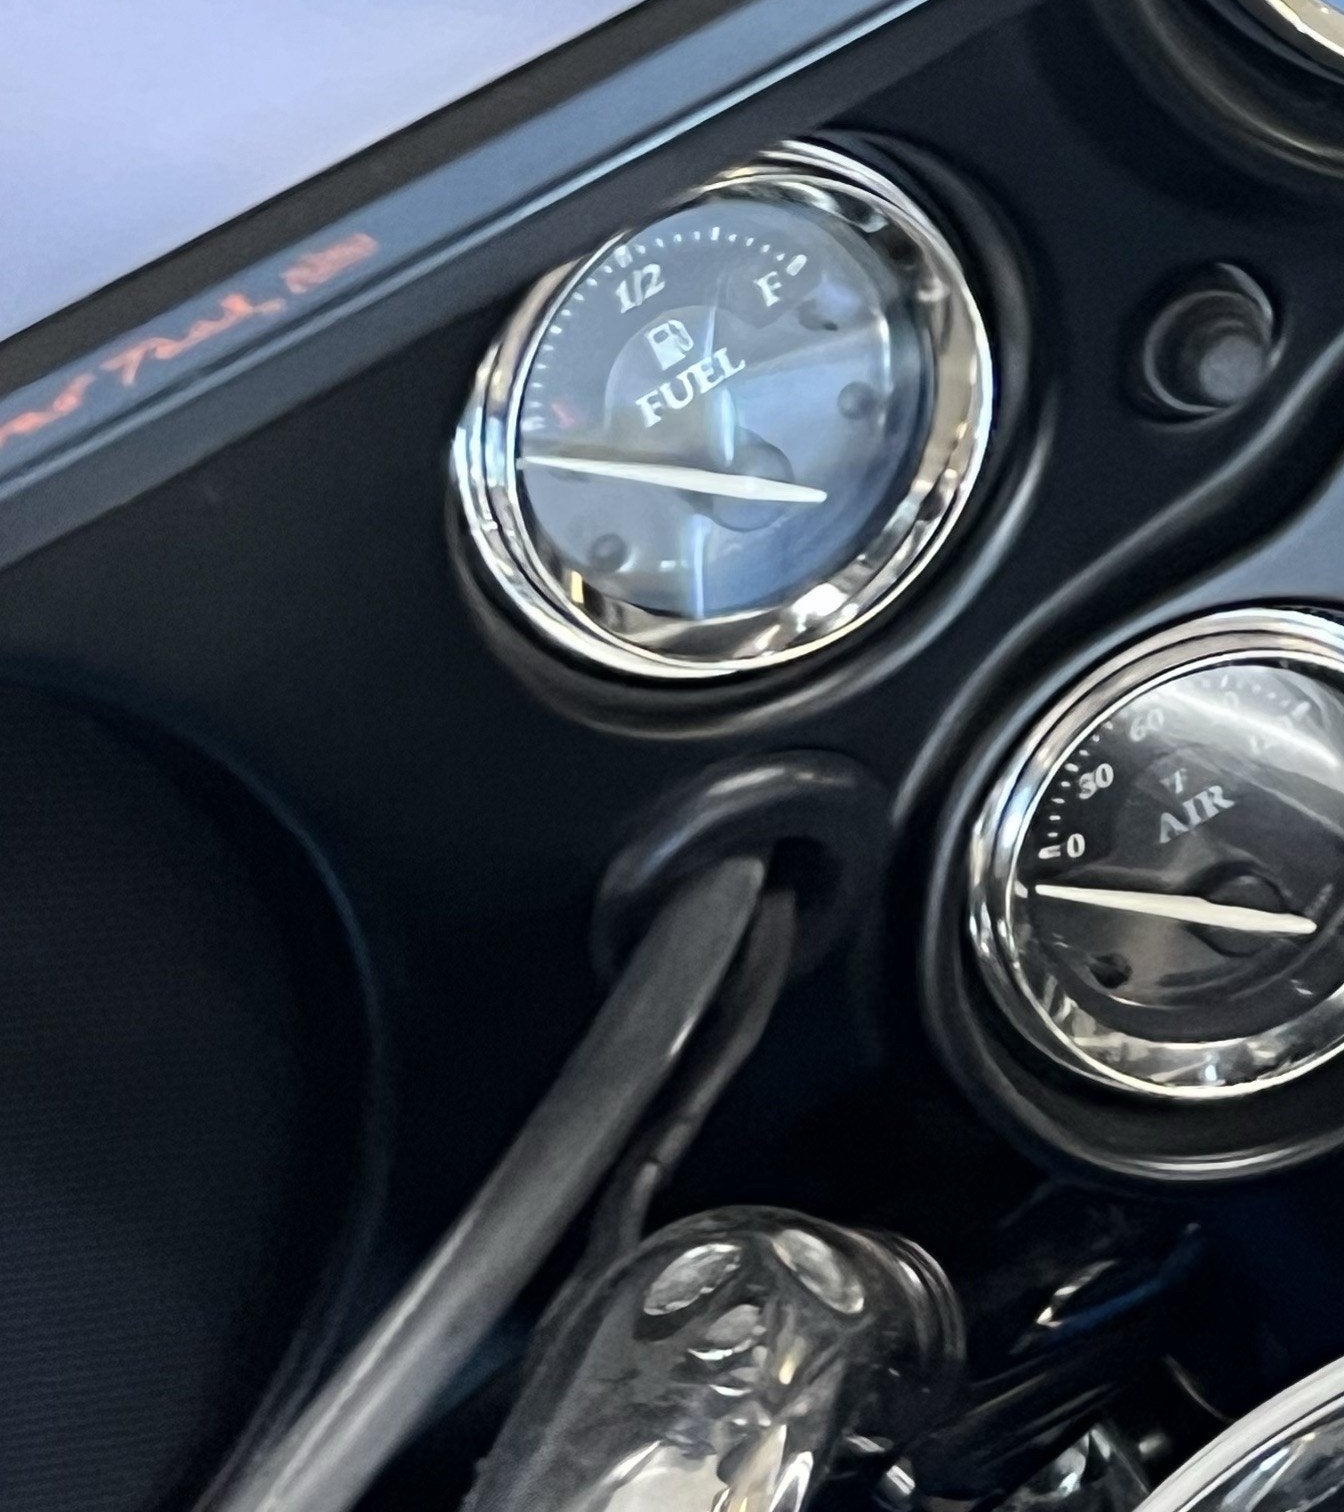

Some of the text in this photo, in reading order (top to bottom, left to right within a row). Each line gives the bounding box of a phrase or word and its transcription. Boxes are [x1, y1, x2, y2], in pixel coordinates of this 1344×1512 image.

[615, 263, 665, 313] 1/2
[754, 271, 782, 307] F
[635, 347, 745, 428] FUEL
[1129, 708, 1164, 742] 60
[1078, 763, 1114, 799] 30
[1158, 785, 1236, 844] AIR
[1067, 833, 1086, 858] 0
